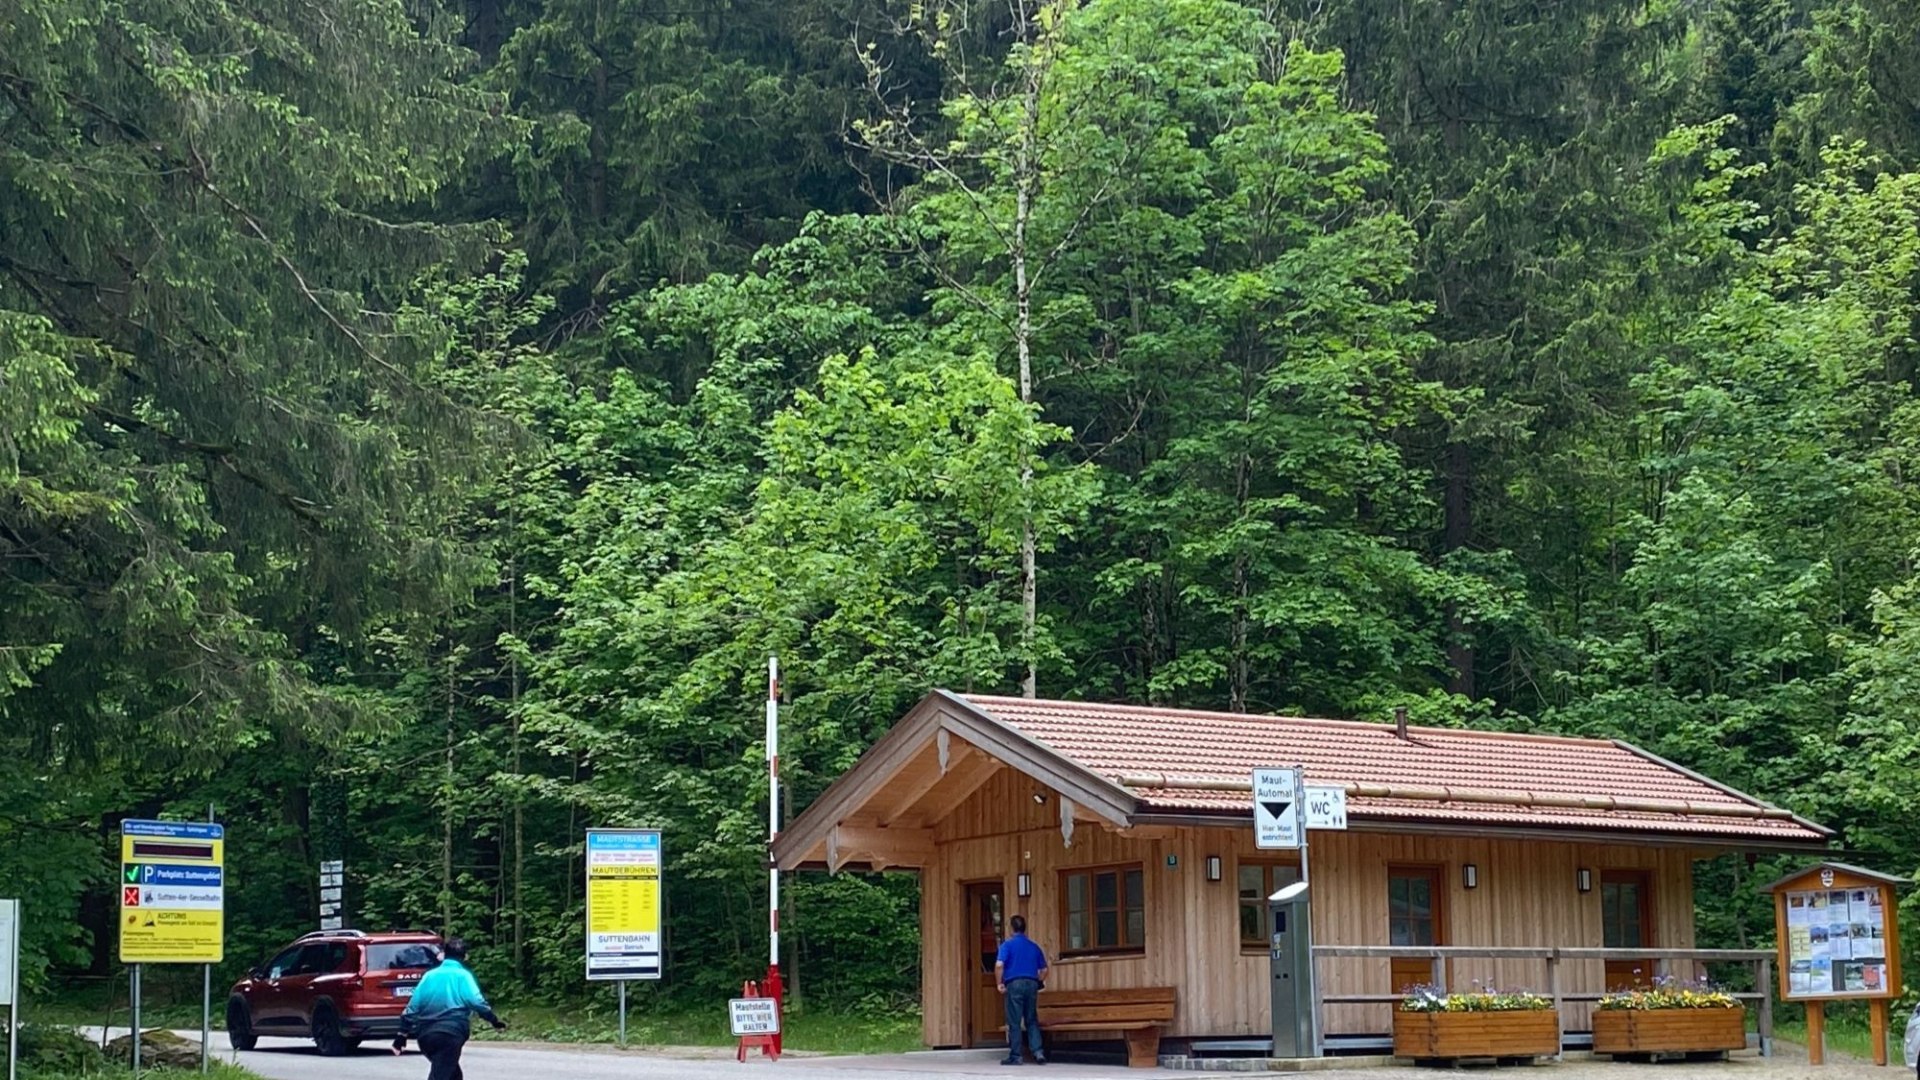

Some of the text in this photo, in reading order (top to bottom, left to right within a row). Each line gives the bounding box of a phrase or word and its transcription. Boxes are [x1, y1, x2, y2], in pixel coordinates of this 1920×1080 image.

[1257, 788, 1293, 798] Automat
[1310, 801, 1331, 816] WC
[1262, 824, 1276, 832] Hier
[592, 865, 657, 874] MAUTGEBÜHREN
[598, 934, 651, 943] SUTTENBAHN
[735, 1002, 771, 1011] Mautstelle
[735, 1013, 755, 1023] BITTE
[743, 1023, 768, 1031] HALTEN
